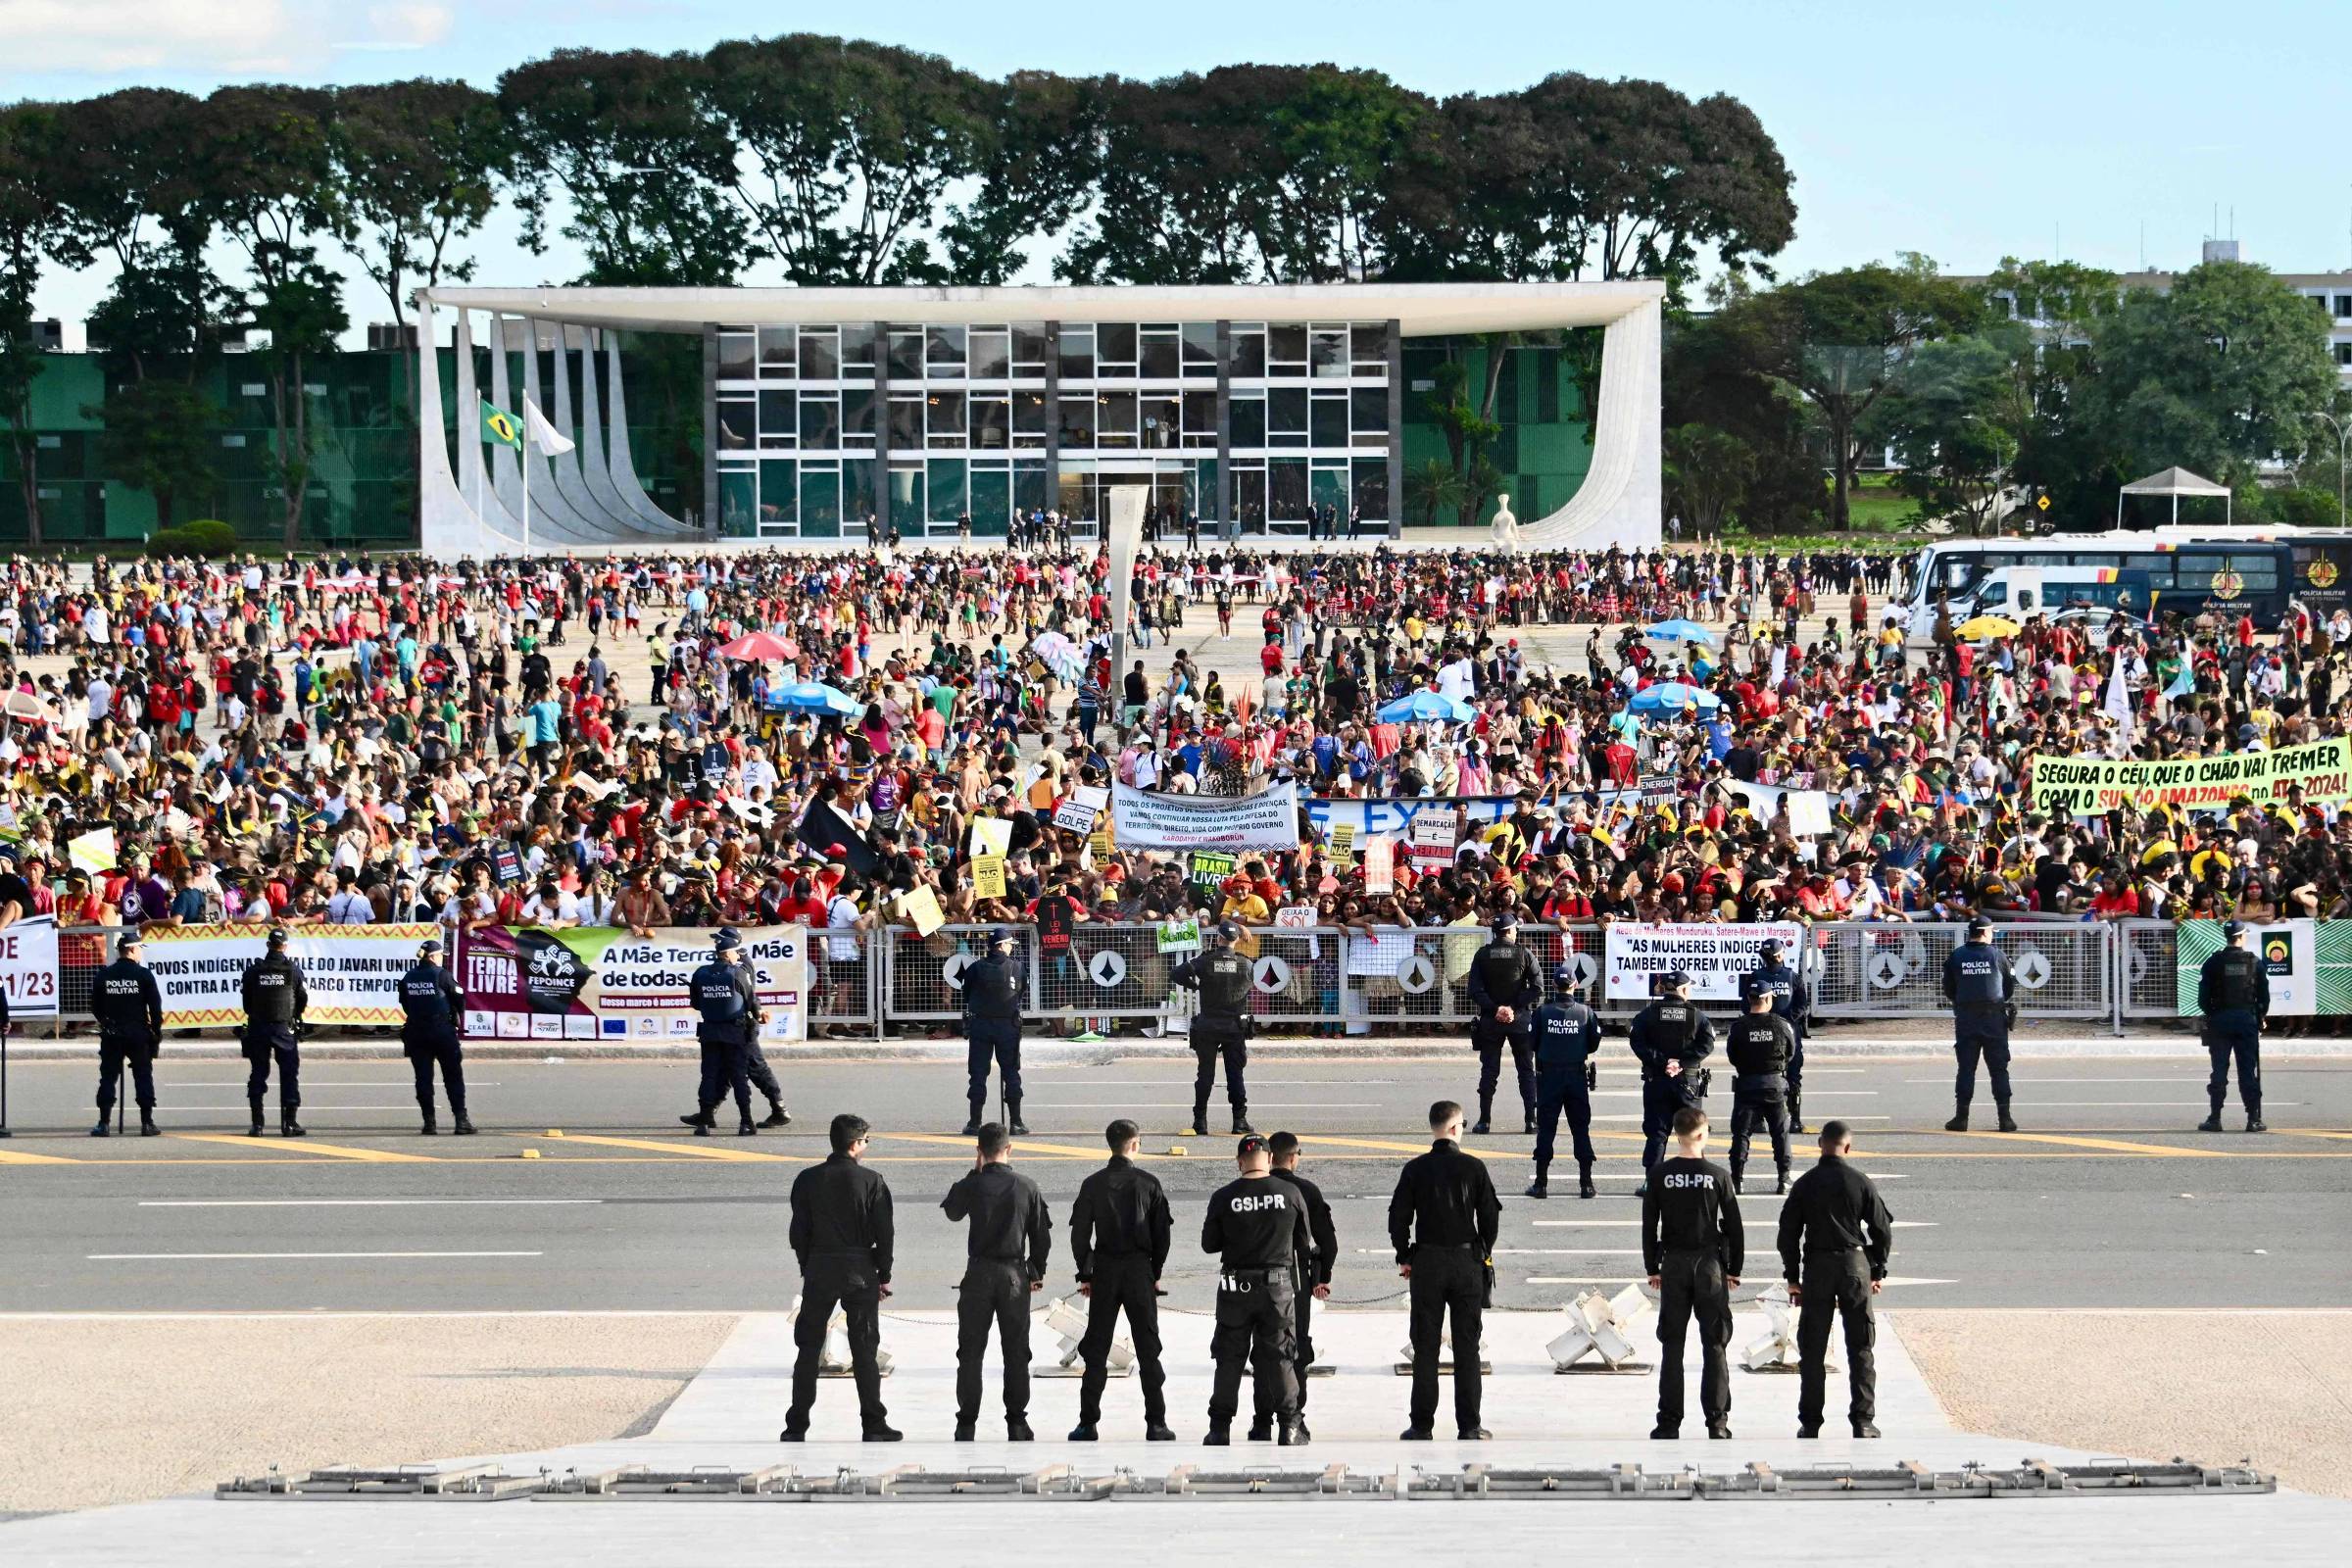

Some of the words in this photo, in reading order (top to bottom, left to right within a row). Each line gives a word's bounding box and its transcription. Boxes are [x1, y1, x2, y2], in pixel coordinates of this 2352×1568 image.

[2037, 763, 2100, 784] SEGURA
[2104, 767, 2115, 784] O
[2120, 764, 2149, 786] CÉU,
[2153, 765, 2181, 786] QUE
[2184, 765, 2194, 783] O
[2200, 760, 2240, 781] CHÃO
[2244, 758, 2267, 778] VAI
[2272, 746, 2340, 773] TREMER
[1641, 778, 1675, 789] ENERGIA
[2039, 788, 2080, 810] COM
[2083, 789, 2094, 808] O
[2252, 787, 2269, 800] no
[2303, 772, 2348, 796] 2024!
[1152, 804, 1183, 812] PROJETOS
[1642, 793, 1675, 807] FUTURO
[1057, 812, 1090, 830] GOLPE
[1152, 813, 1191, 823] CONTINUAR
[1251, 820, 1284, 829] GOVERNO
[1416, 818, 1456, 830] DEMARCAÇÃO
[1331, 843, 1350, 856] NÃO
[1194, 858, 1231, 875] BRASIL
[1643, 926, 1674, 936] Mulheres
[1676, 926, 1715, 937] Munduruku,
[604, 949, 617, 963] A
[622, 946, 662, 963] Mãe
[666, 948, 716, 963] Terra
[752, 940, 794, 959] Mãe
[1627, 939, 1647, 954] "AS
[1652, 939, 1715, 955] MULHERES
[1720, 937, 1764, 955] INDÍGE
[148, 960, 189, 976] POVOS
[193, 956, 260, 974] INDÍGENA
[318, 957, 334, 971] DO
[339, 957, 382, 972] JAVARI
[466, 956, 517, 976] TERRA
[1617, 955, 1666, 971] TAMBÉM
[1670, 956, 1719, 971] SOFREM
[467, 972, 517, 995] LIVRE
[528, 975, 575, 988] FEPOINCE
[603, 970, 627, 987] de
[631, 969, 686, 988] todas
[1770, 980, 1789, 989] LÍCIA
[167, 980, 218, 995] CONTRA
[221, 980, 229, 994] A
[601, 997, 626, 1007] Nosso
[626, 998, 652, 1007] marco
[653, 998, 659, 1006] é
[1664, 1173, 1714, 1190] GSI-PR
[1231, 1194, 1286, 1212] GSI-PR
